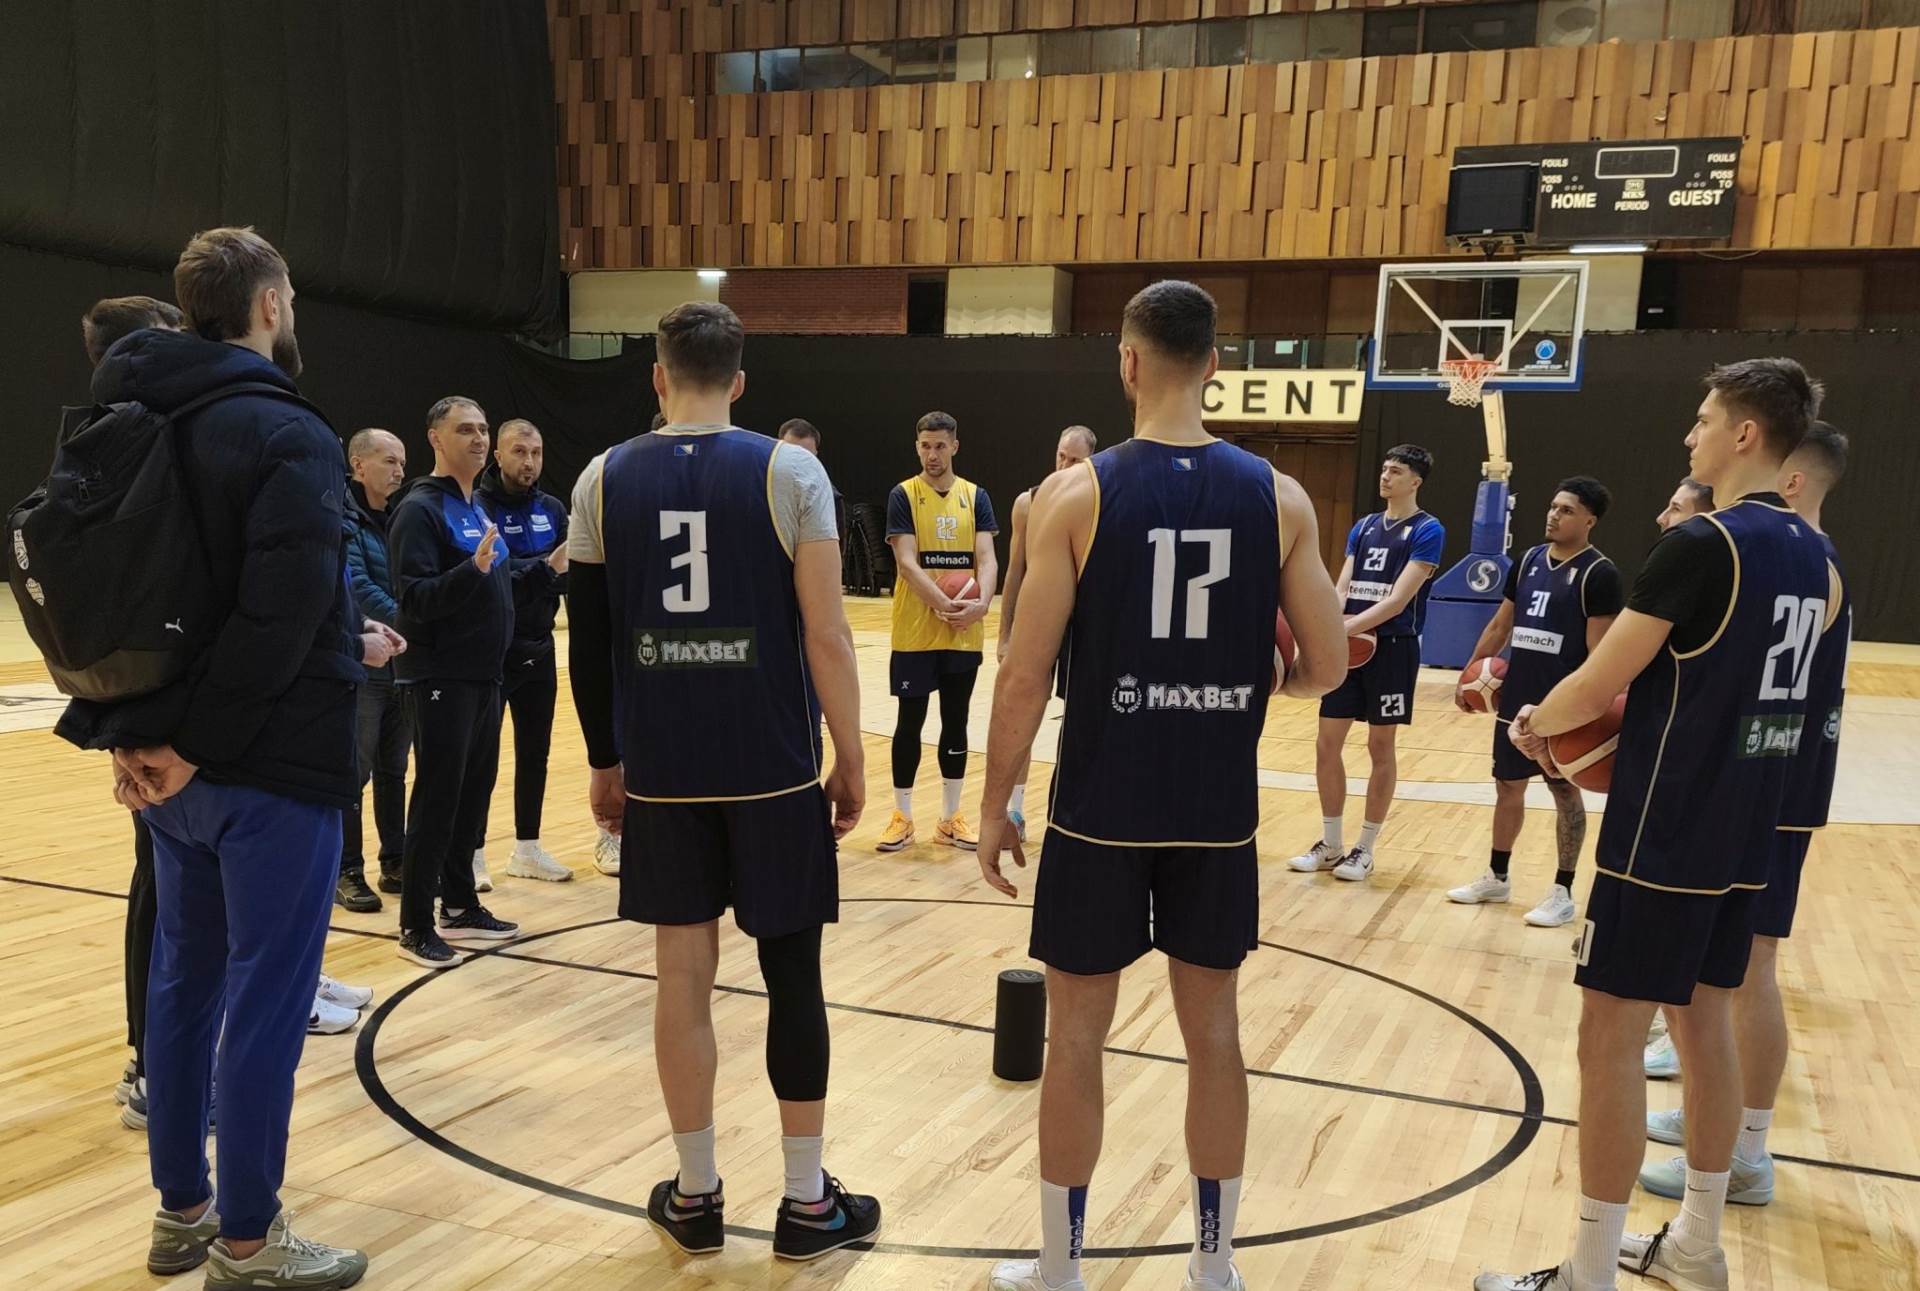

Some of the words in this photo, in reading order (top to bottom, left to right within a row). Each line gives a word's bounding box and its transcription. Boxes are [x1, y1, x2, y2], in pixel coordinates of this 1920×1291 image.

[1541, 158, 1569, 168] FOULS
[1707, 153, 1736, 163] FOULS
[1710, 169, 1735, 180] POSS
[1718, 180, 1733, 189] TO
[1551, 192, 1598, 210] HOME
[1614, 200, 1650, 212] PERIOD
[1668, 189, 1725, 207] GUEST
[1201, 379, 1357, 415] CENT
[935, 515, 958, 540] 22
[659, 510, 711, 613] 3
[1363, 547, 1389, 572] 23
[1147, 527, 1232, 639] 17
[1526, 590, 1552, 618] 31
[660, 639, 750, 664] MAXBET
[1758, 594, 1827, 701] 20
[1147, 683, 1255, 712] MAXBET
[1380, 693, 1405, 717] 23
